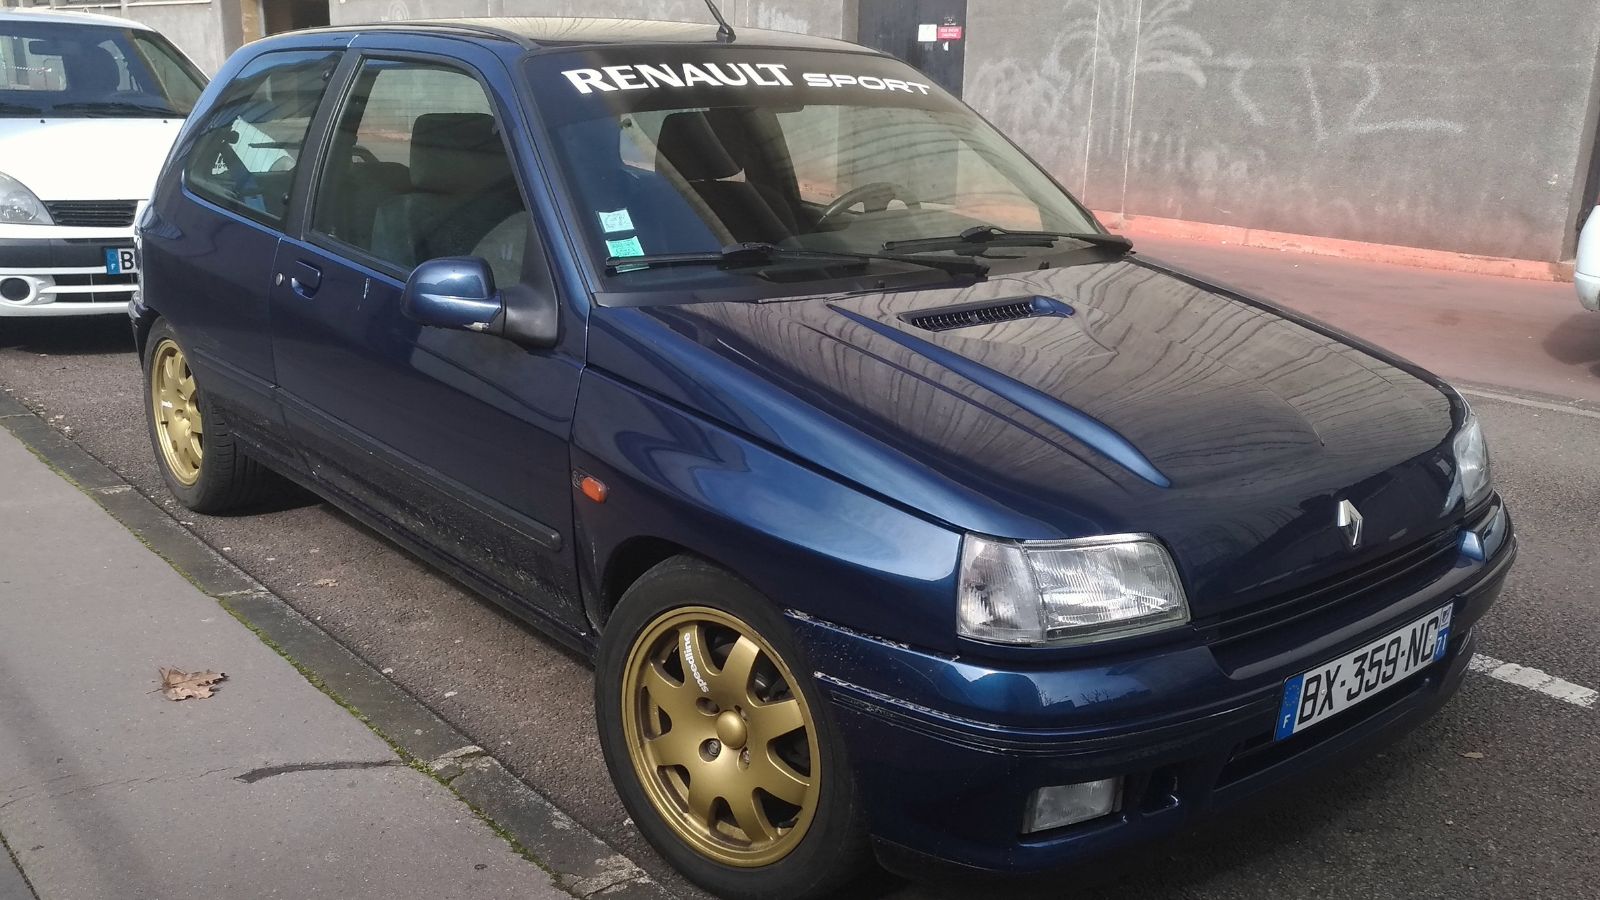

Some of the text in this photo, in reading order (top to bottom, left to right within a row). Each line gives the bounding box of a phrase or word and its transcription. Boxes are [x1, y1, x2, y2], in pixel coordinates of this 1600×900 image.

[561, 62, 931, 95] RENAULT SPORT
[120, 250, 135, 271] B
[1435, 633, 1448, 655] 71
[683, 632, 710, 693] speedline
[1297, 615, 1439, 726] BX-359-NC
[1282, 714, 1292, 729] F
